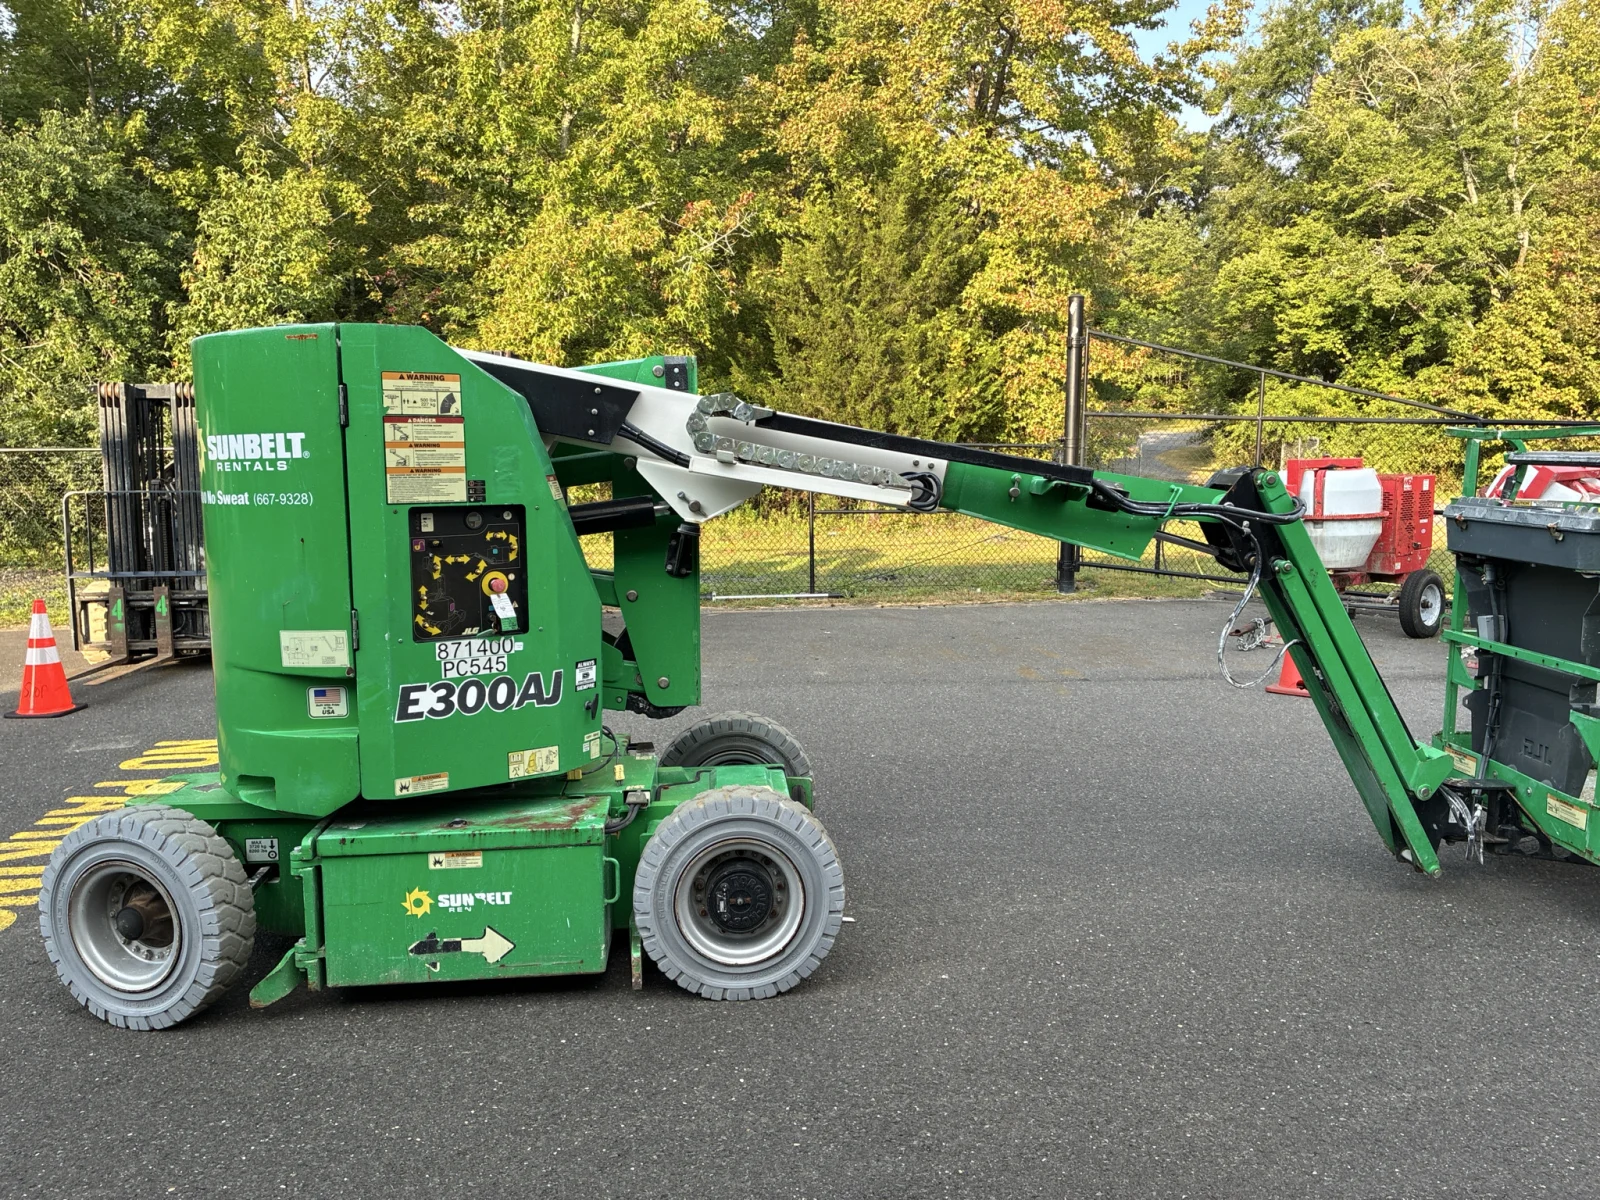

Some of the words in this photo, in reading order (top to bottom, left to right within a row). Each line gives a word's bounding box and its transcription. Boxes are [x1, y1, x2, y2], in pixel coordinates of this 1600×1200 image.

[216, 461, 288, 472] RENTALS
[207, 490, 216, 504] No
[217, 490, 250, 505] Sweat
[253, 492, 314, 507] (667-9328)
[112, 598, 123, 621] 4
[156, 594, 168, 616] 4
[461, 627, 480, 635] JLG
[437, 638, 514, 660] 871400
[443, 656, 507, 678] PC545
[396, 670, 563, 722] E300AJ
